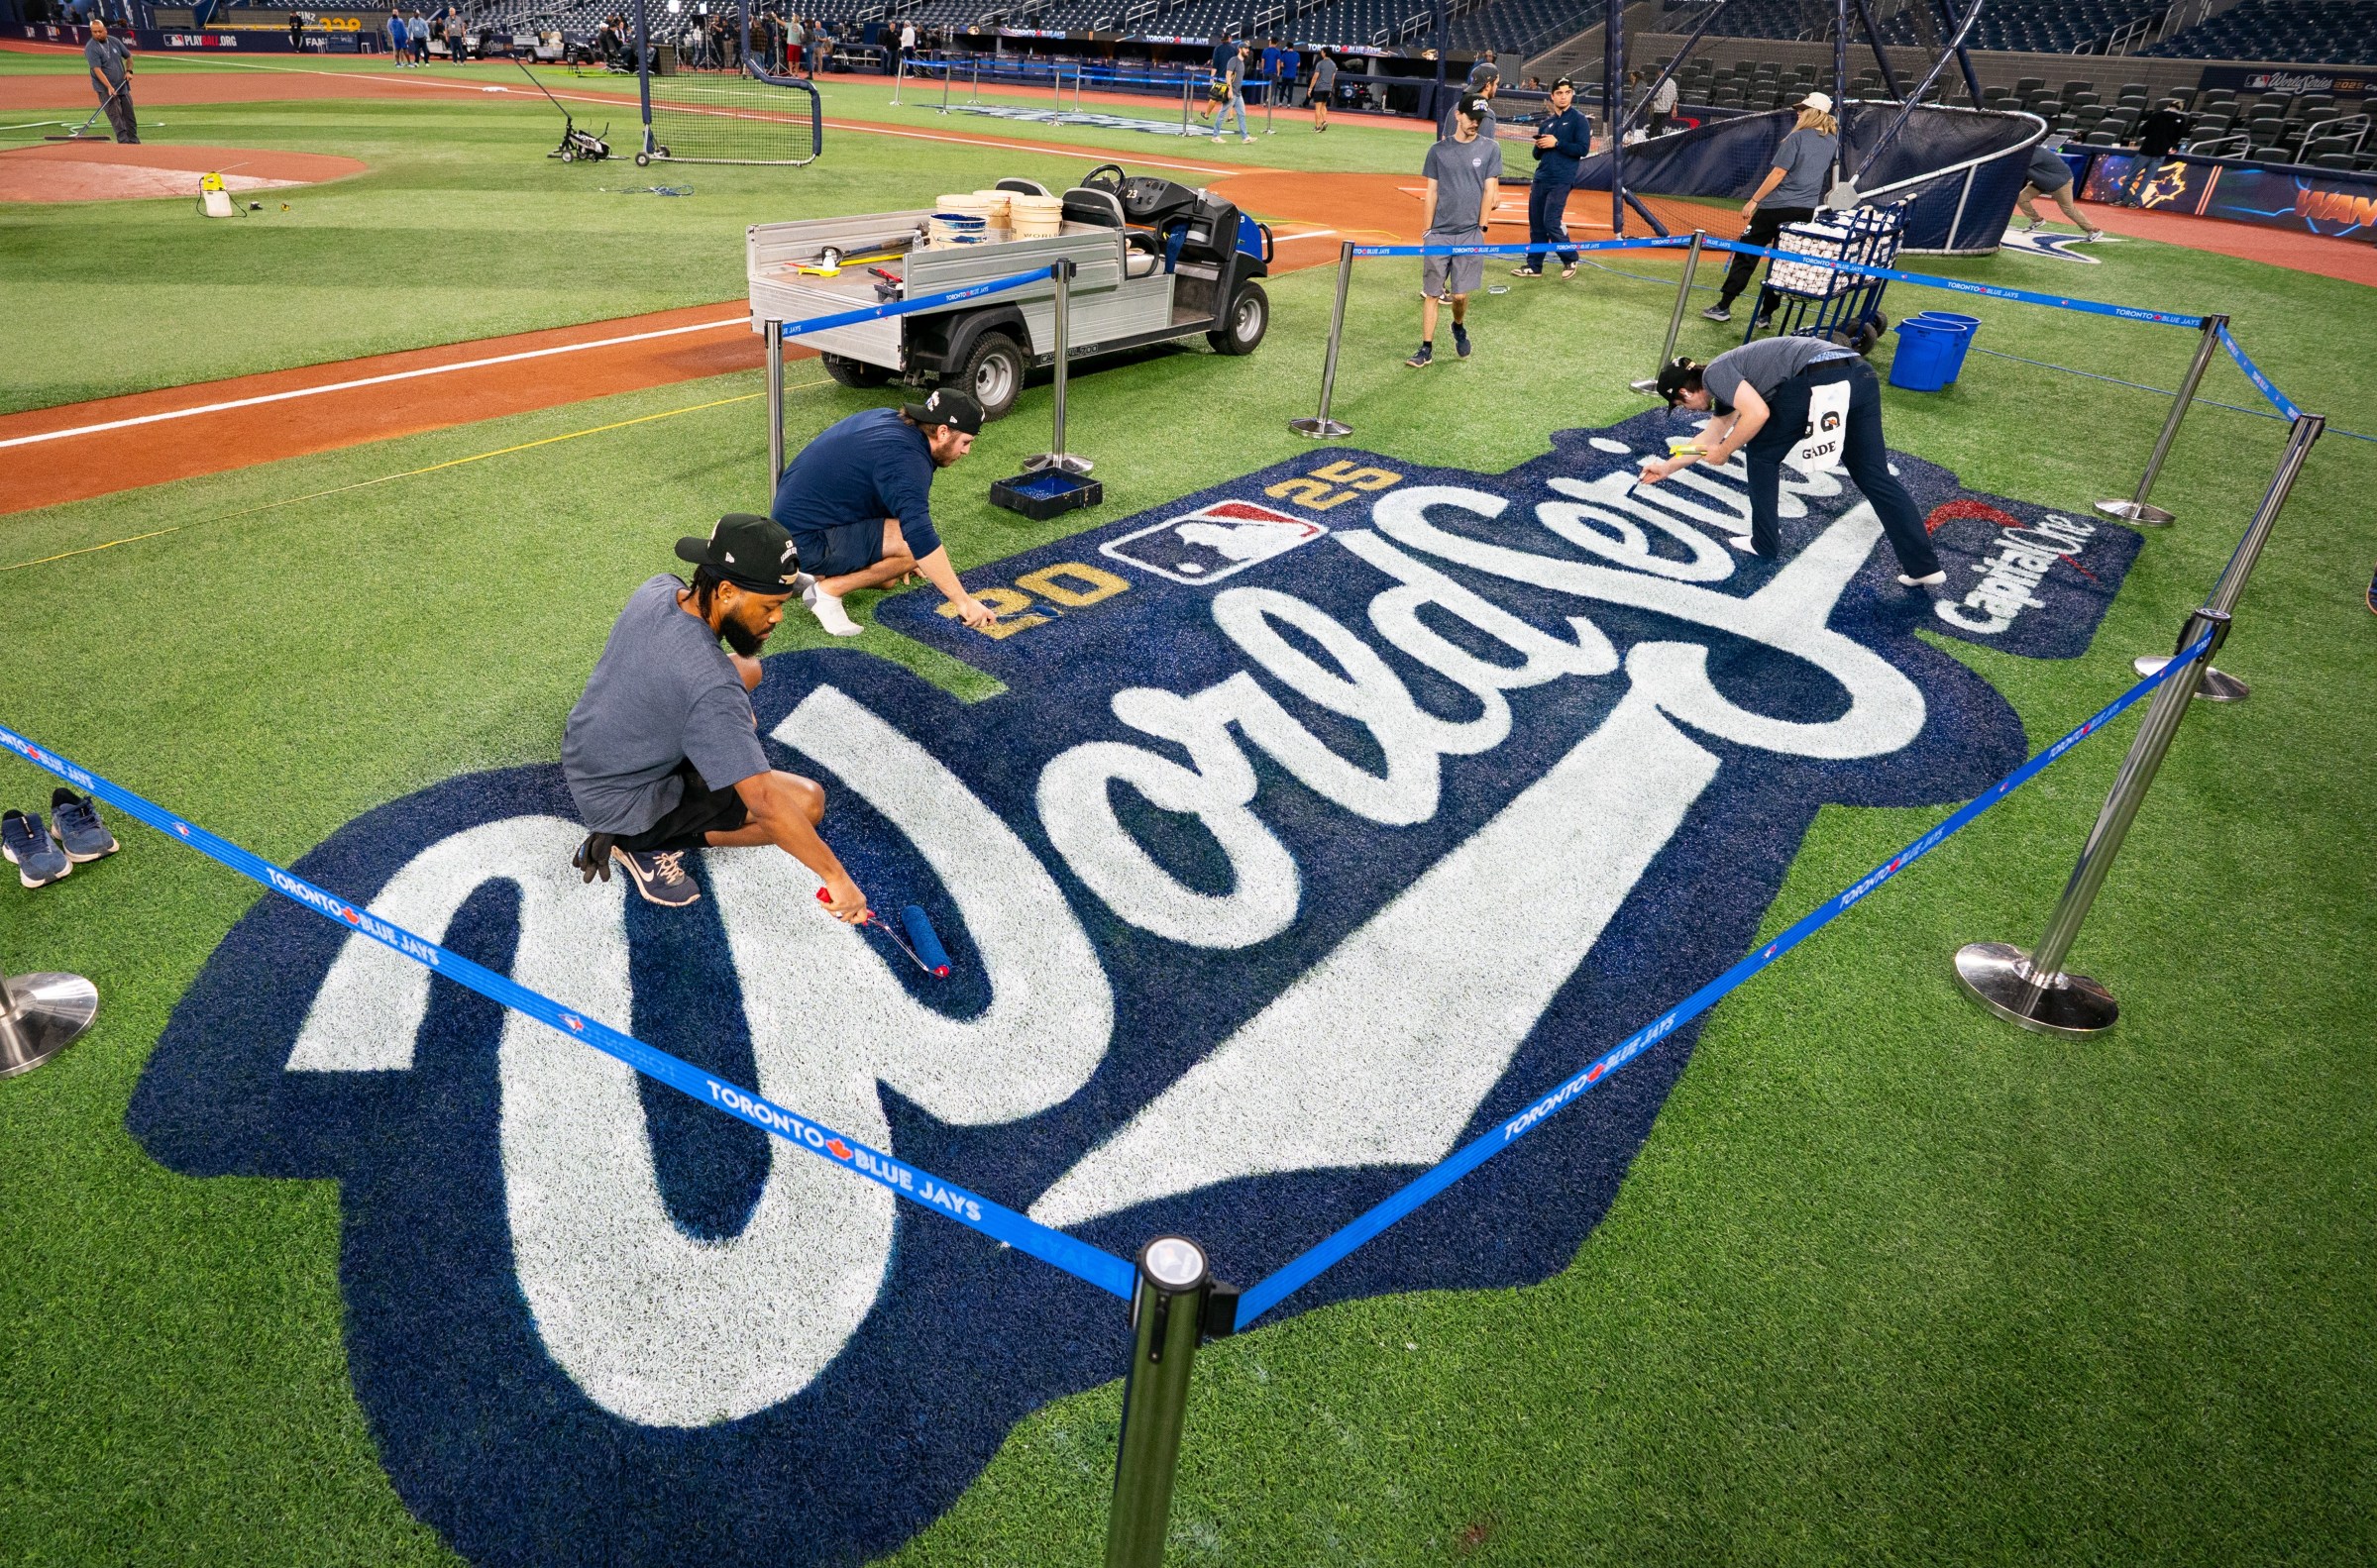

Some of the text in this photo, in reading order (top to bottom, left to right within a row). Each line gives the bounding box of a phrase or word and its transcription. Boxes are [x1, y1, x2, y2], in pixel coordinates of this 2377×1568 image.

[184, 35, 237, 47] PLAYBALL.ORG
[1011, 28, 1036, 37] TORONTO
[1145, 35, 1174, 44] TORONTO
[1308, 44, 1342, 53] TORTO
[1348, 46, 1364, 54] BLUE
[1126, 189, 1138, 199] 23
[1802, 257, 1830, 267] TORONTO
[945, 291, 967, 302] TORONTO
[979, 285, 990, 294] JAYS
[1947, 281, 1980, 292] TORONTO
[2002, 290, 2019, 299] JAYS
[2115, 308, 2200, 327] TORONTO BLUE JAYS
[789, 325, 803, 335] JAYS
[1080, 344, 1099, 356] 700
[935, 460, 1403, 640] 20 25
[40, 751, 63, 773] BLUE
[60, 765, 95, 790] JAYS
[1839, 825, 1945, 909] TORONTO BLUE JAYS
[266, 868, 439, 966] TORONTO BLUE JAYS
[286, 528, 1619, 1427] World
[1505, 1012, 1676, 1141] TORONTO BLUE JAYS
[706, 1080, 982, 1221] TORONTO BLUE JAYS
